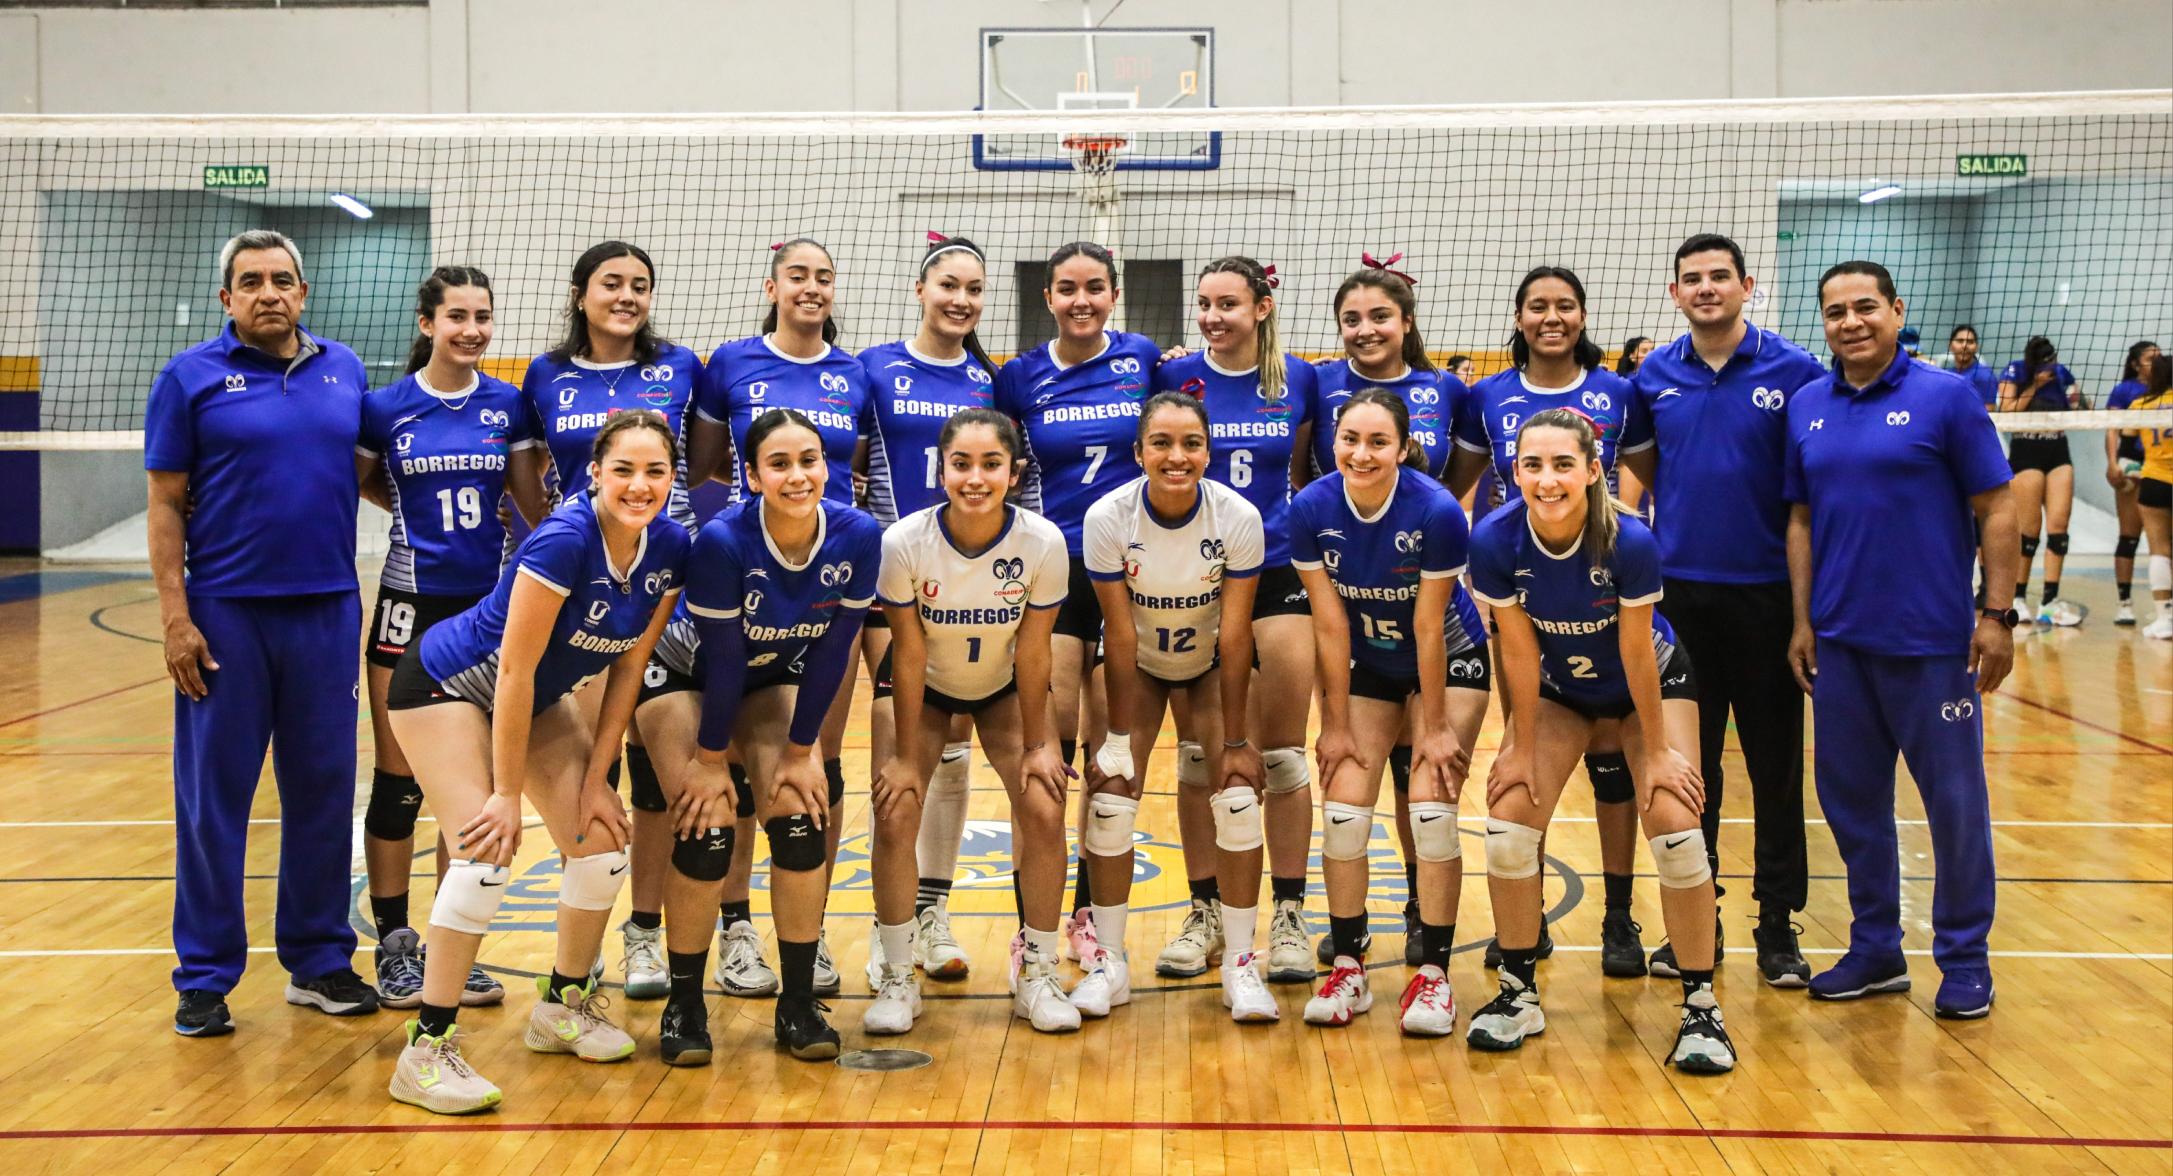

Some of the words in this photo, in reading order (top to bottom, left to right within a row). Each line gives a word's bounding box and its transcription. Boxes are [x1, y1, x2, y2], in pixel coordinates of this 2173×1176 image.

[205, 168, 267, 186] SALIDA
[1960, 157, 2025, 174] SALIDA
[893, 399, 969, 418] BORRE
[1043, 401, 1142, 425] BORREGOS
[1208, 421, 1290, 438] RREGOS
[401, 453, 506, 476] BORREGOS
[1081, 445, 1108, 485] 7
[1229, 449, 1254, 488] 6
[436, 486, 482, 532] 19
[379, 598, 416, 645] 19
[921, 603, 1021, 625] BORREGOS
[1527, 613, 1618, 635] ORREGOS
[1360, 612, 1404, 641] 15
[568, 629, 644, 653] BORREG
[966, 637, 982, 663] 1
[1155, 627, 1196, 653] 12
[1566, 655, 1598, 679] 2
